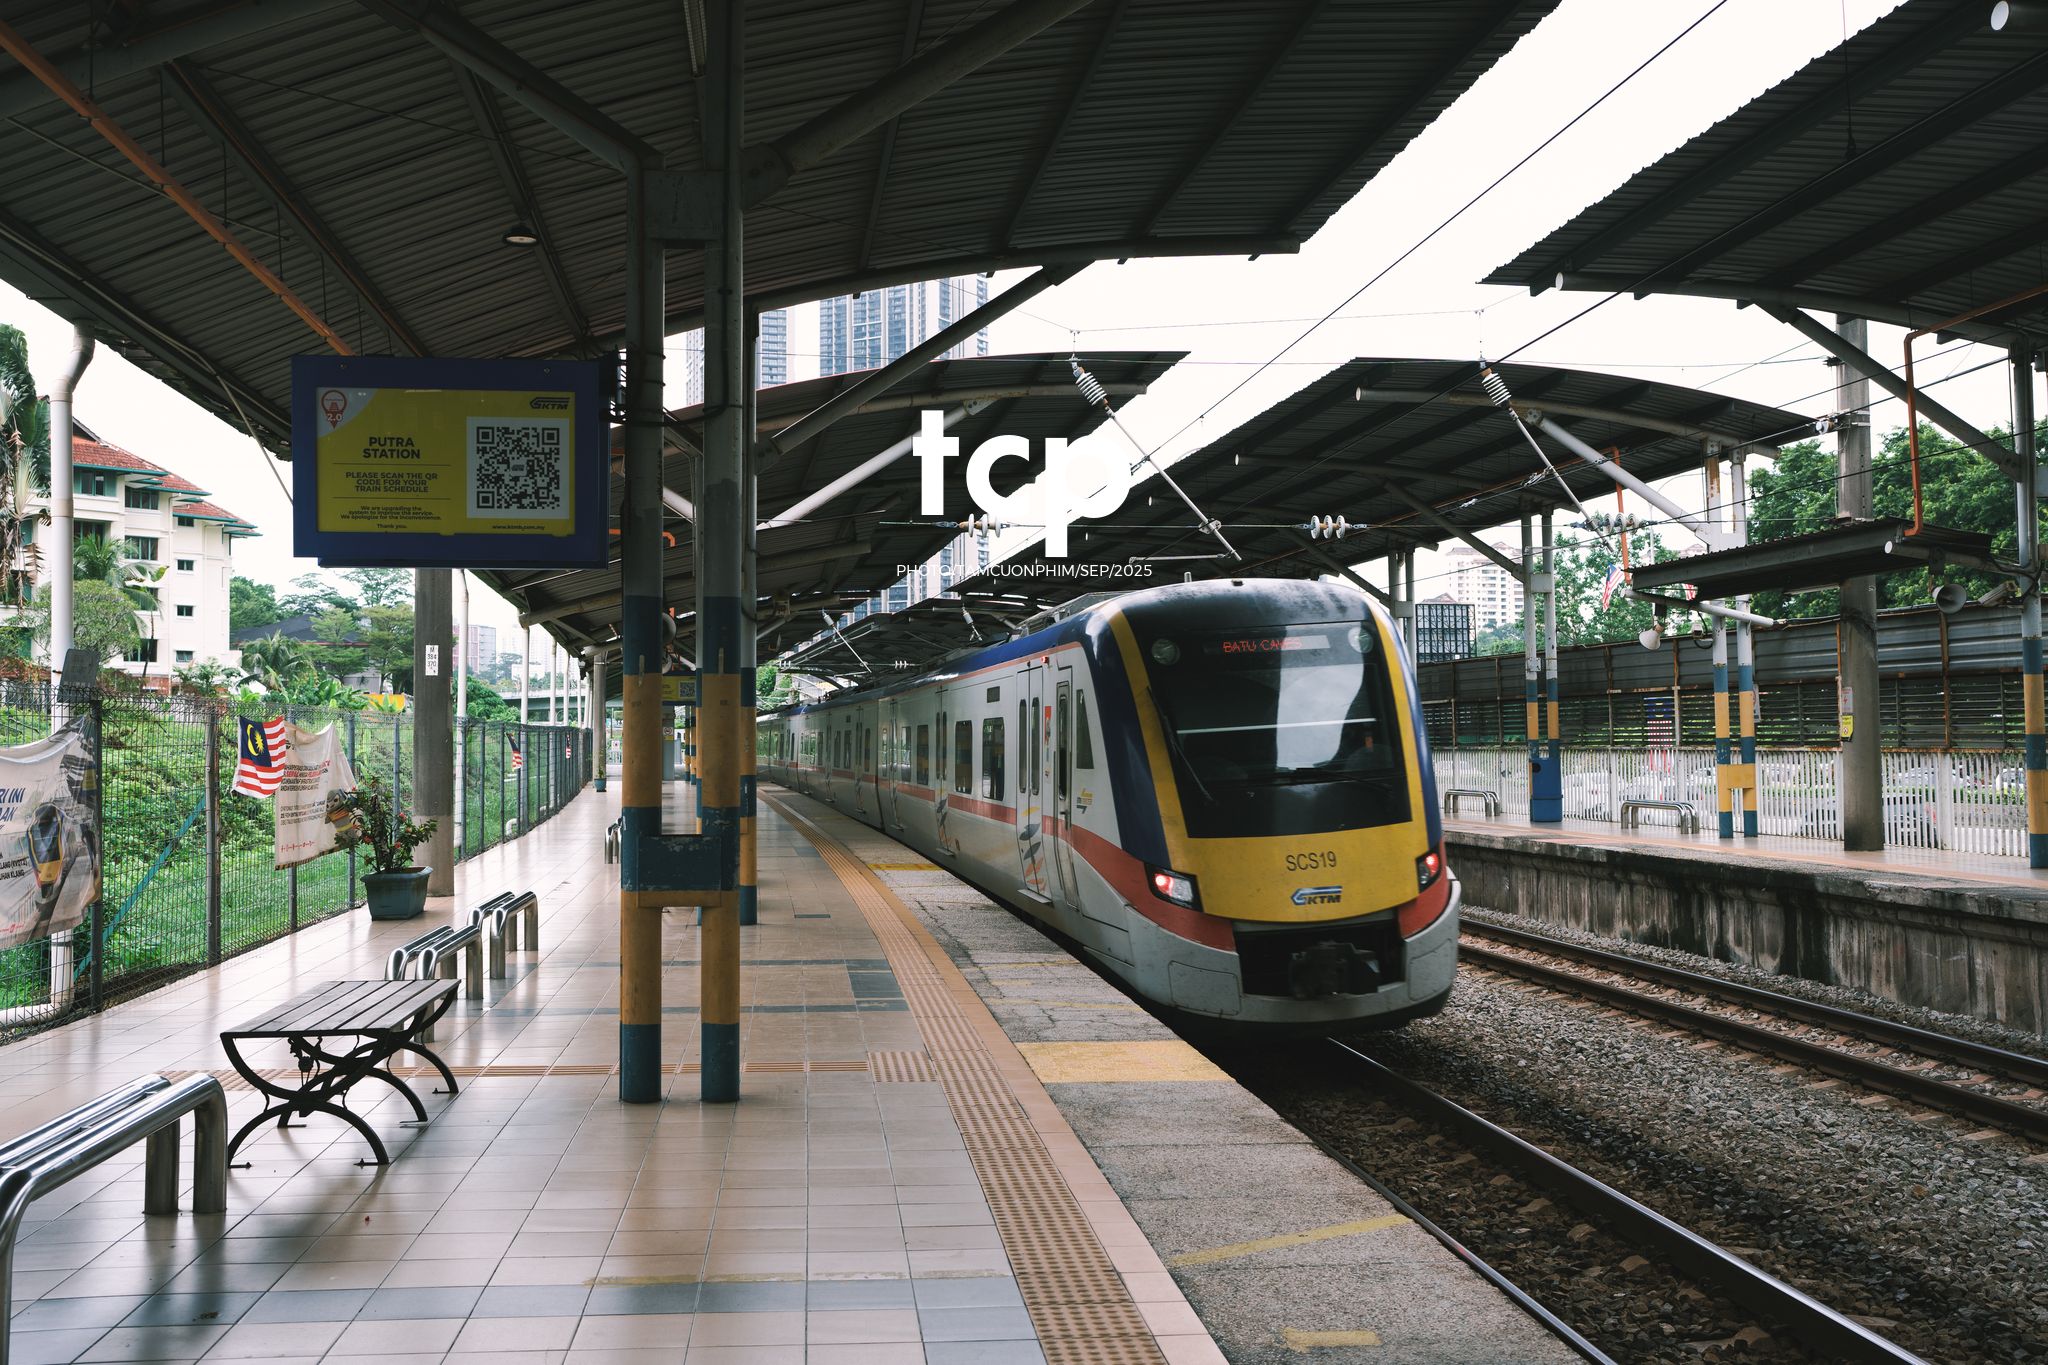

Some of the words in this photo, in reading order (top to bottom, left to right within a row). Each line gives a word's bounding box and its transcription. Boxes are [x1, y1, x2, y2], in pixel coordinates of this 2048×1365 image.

[368, 436, 415, 448] PUTRA
[362, 448, 421, 459] STATION
[383, 485, 429, 493] SCHEDULE
[1222, 640, 1257, 653] BATU
[1285, 850, 1337, 872] SCS19
